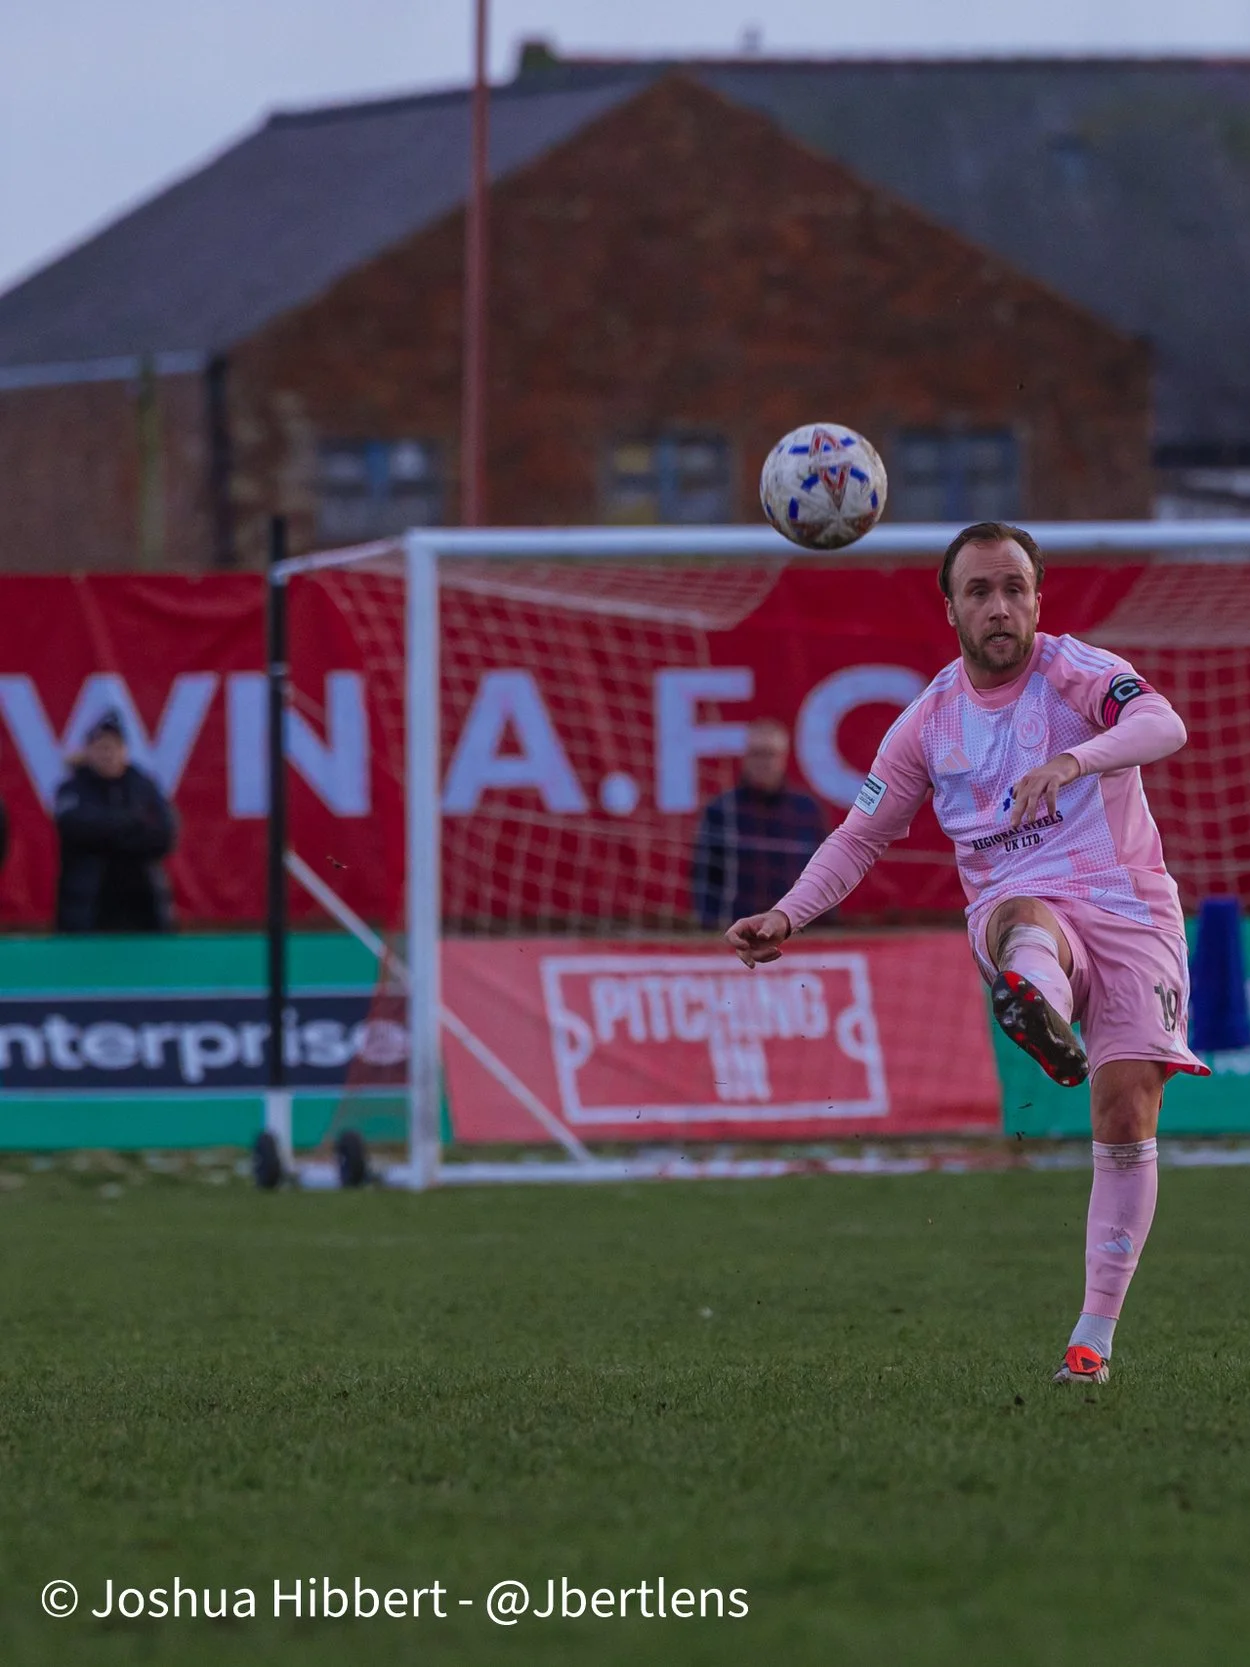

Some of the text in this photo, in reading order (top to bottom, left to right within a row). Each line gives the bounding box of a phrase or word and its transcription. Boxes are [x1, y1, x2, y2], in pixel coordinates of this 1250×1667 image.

[1114, 682, 1140, 701] C
[0, 672, 370, 819] WN
[972, 810, 1064, 851] REGIONAL STEELS
[1004, 838, 1020, 853] UK
[591, 972, 829, 1042] PITCHING
[1154, 983, 1179, 1032] 19
